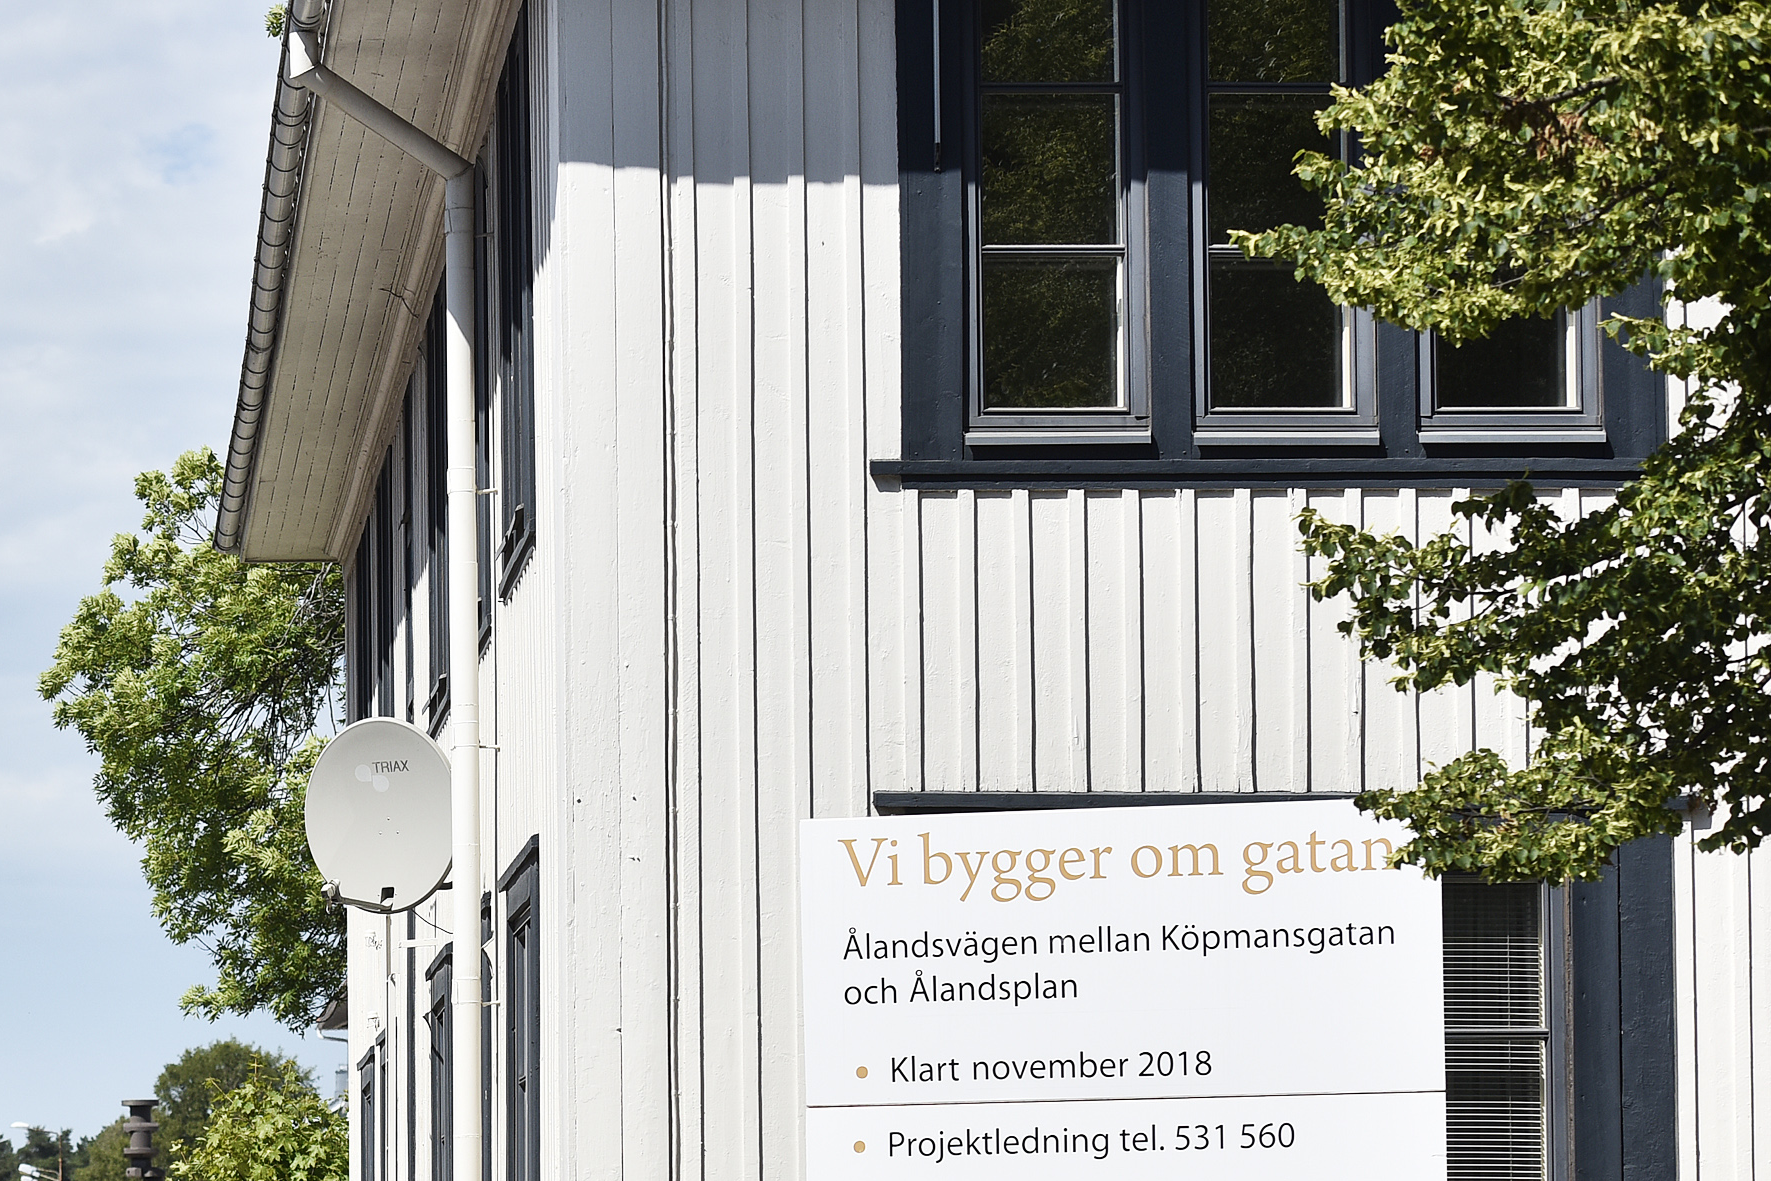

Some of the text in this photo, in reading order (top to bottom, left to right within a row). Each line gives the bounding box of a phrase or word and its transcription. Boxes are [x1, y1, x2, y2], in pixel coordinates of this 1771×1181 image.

[371, 760, 410, 774] TRIAX
[837, 830, 1399, 903] Vi bygger om gatan
[843, 922, 1395, 964] Ålandsvägen mellan Köpmansgatan
[844, 969, 1078, 1007] och Ålandsplan
[891, 1050, 1212, 1083] Klart november 2018
[889, 1122, 1295, 1164] Projektledning tel. 531 560
